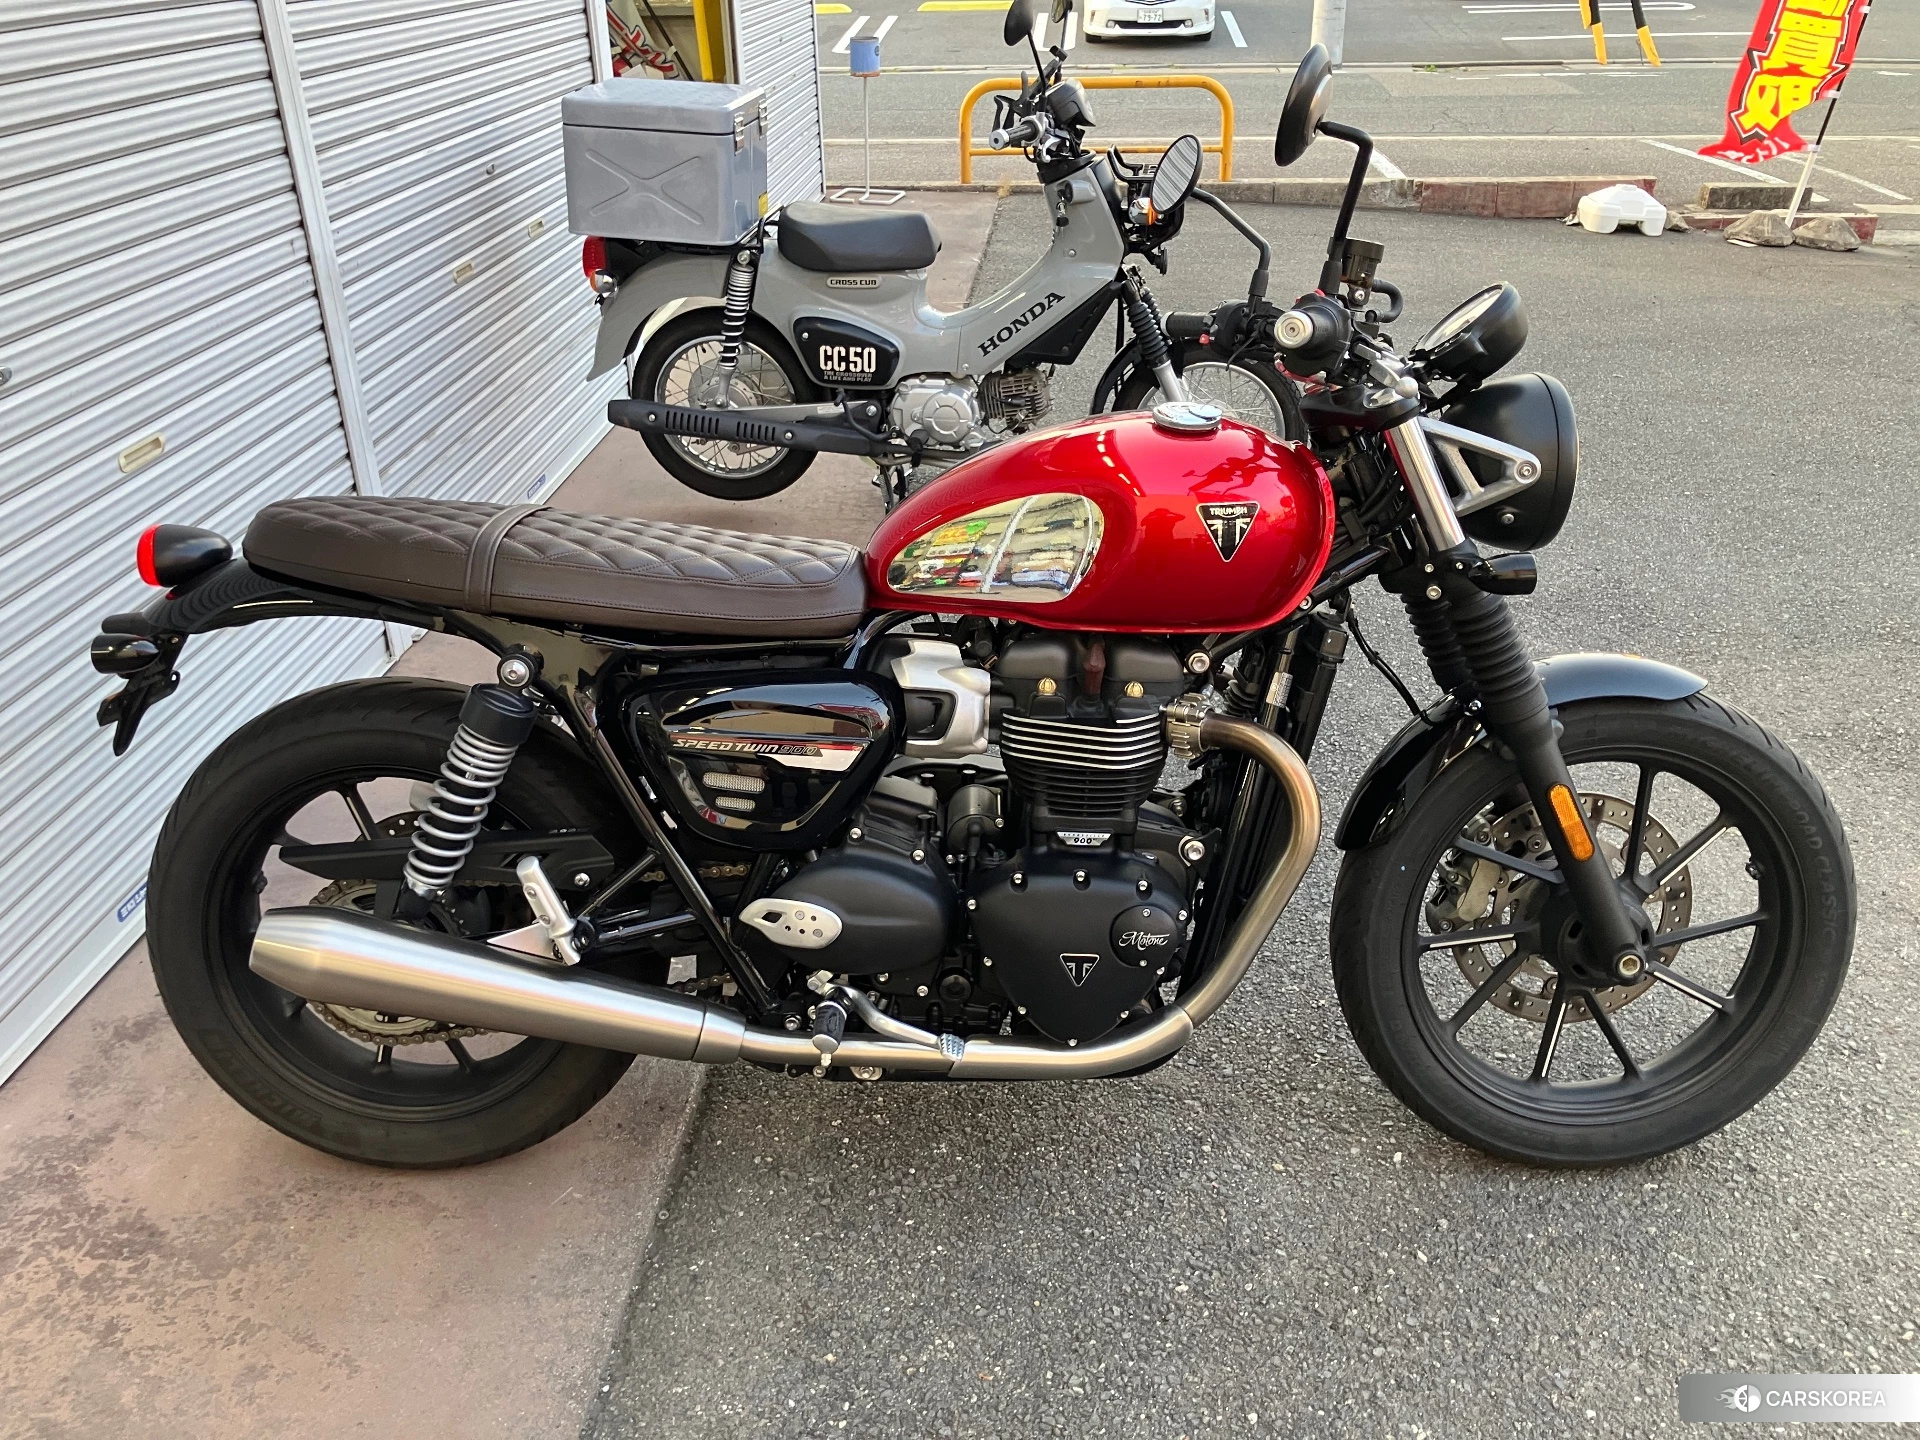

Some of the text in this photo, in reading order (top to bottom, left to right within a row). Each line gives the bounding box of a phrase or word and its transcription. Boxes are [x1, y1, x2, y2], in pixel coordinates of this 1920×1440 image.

[977, 292, 1066, 357] HONDA
[1209, 506, 1248, 516] TRIUMPH
[673, 739, 818, 755] SPEED TWIN 900
[1073, 837, 1093, 845] 900
[1118, 931, 1171, 951] Motone
